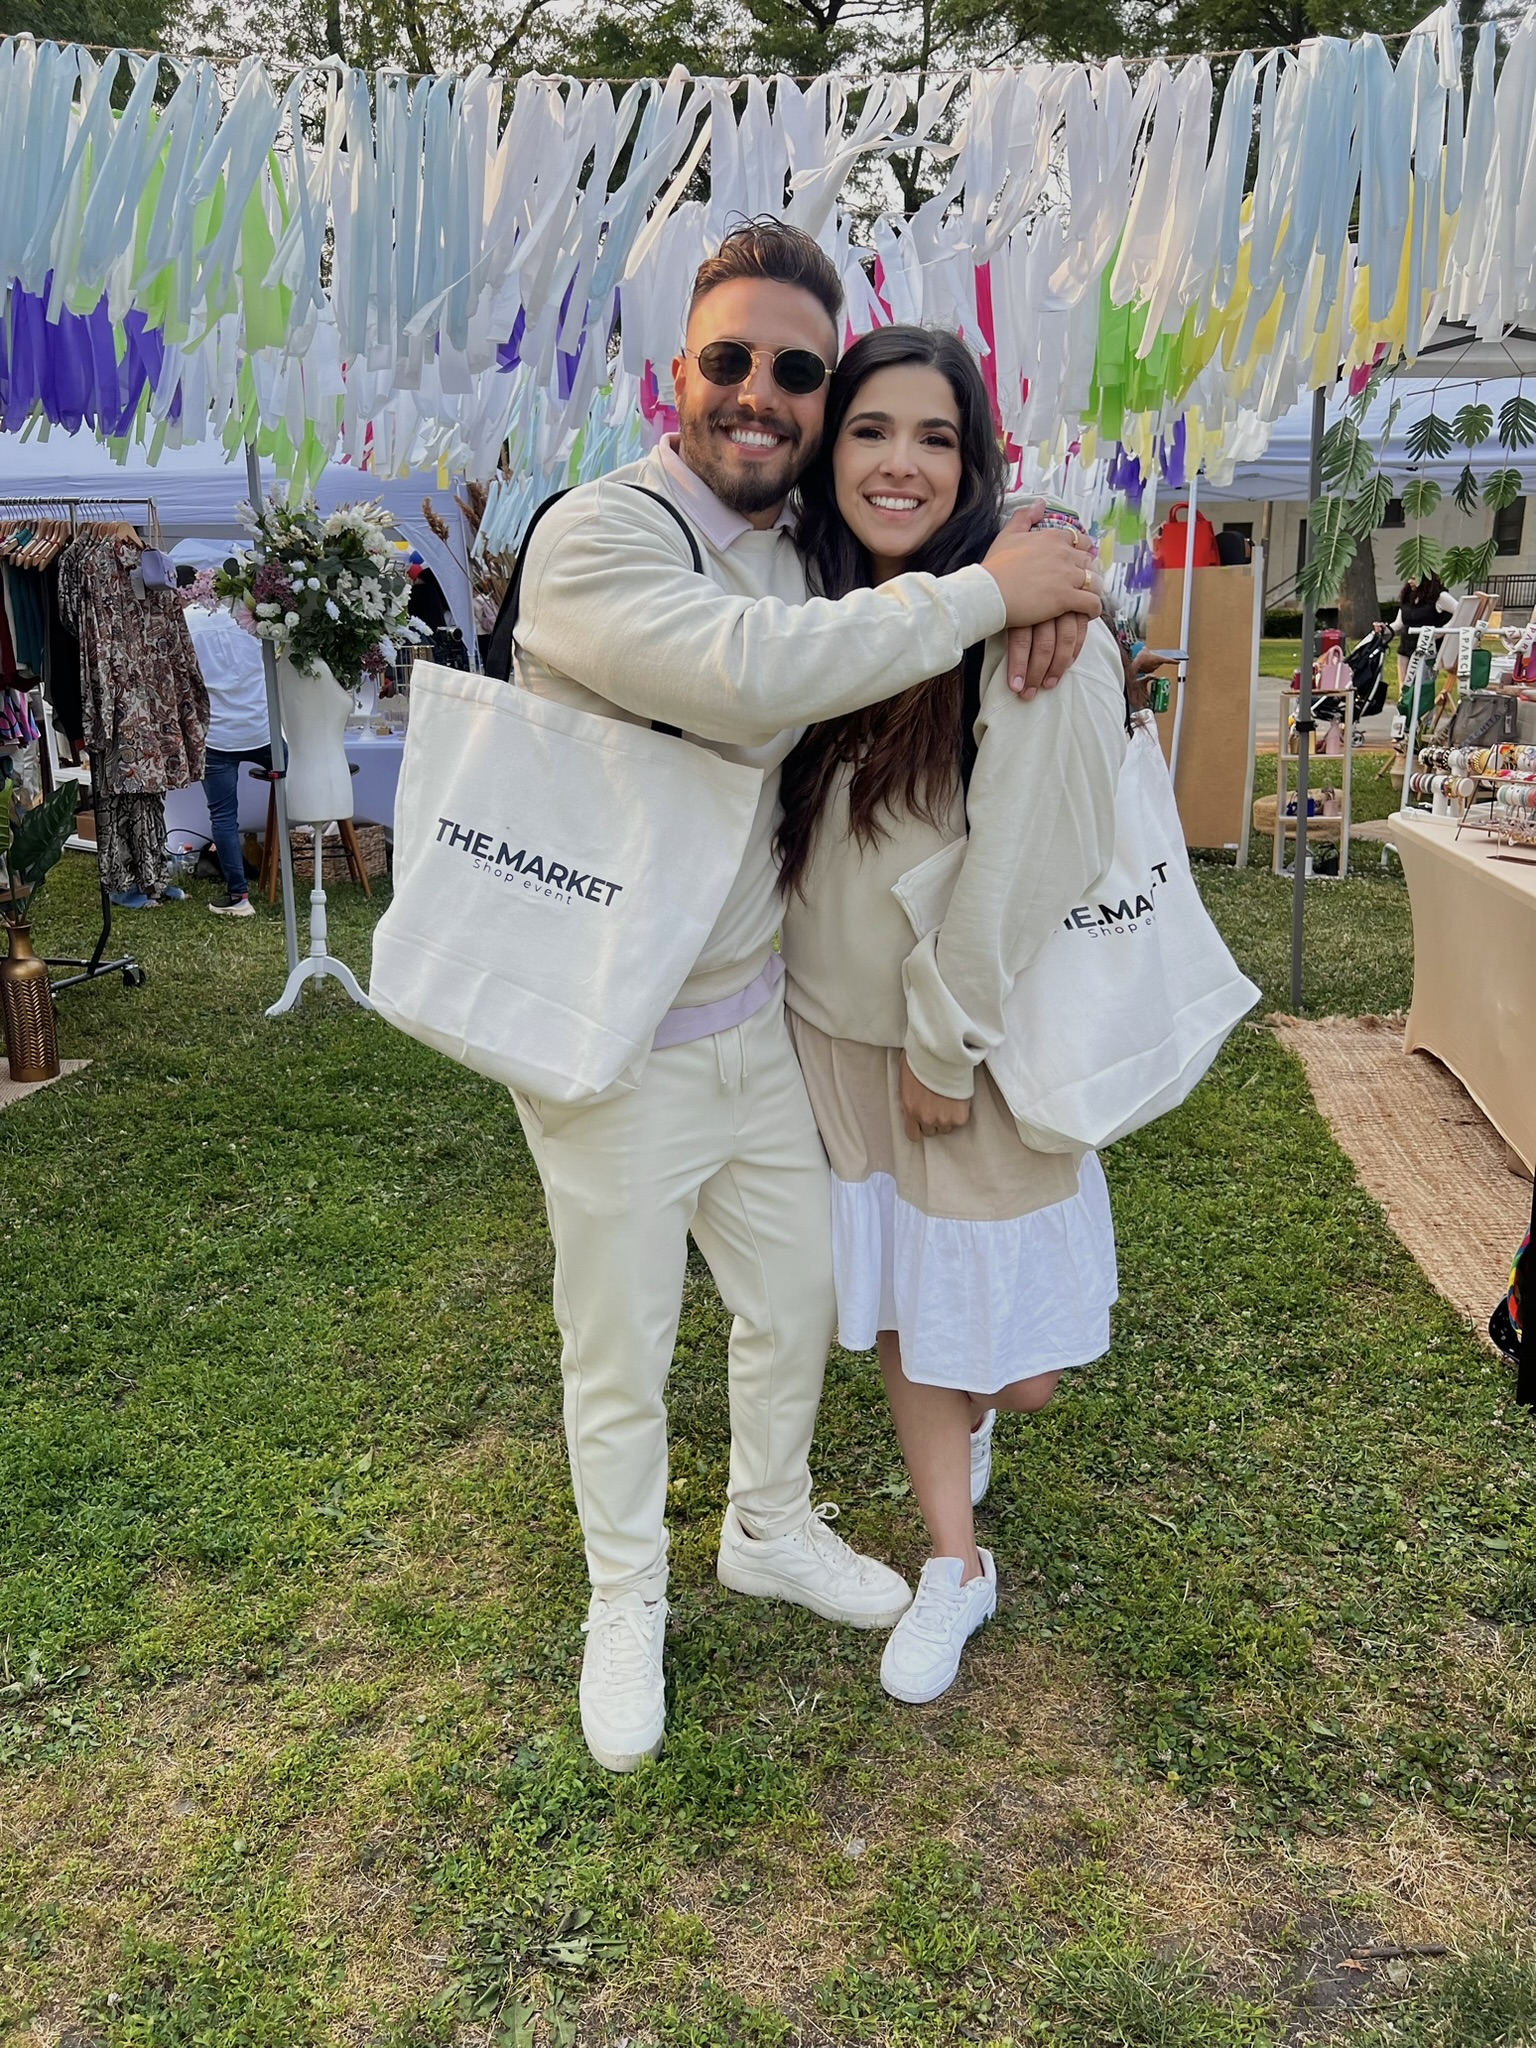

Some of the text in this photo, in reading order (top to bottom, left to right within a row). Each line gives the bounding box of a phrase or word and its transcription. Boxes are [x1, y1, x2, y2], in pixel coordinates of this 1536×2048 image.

[436, 817, 623, 907] THE.MARKET
[472, 858, 572, 905] Shop event
[1088, 923, 1138, 939] Shop
